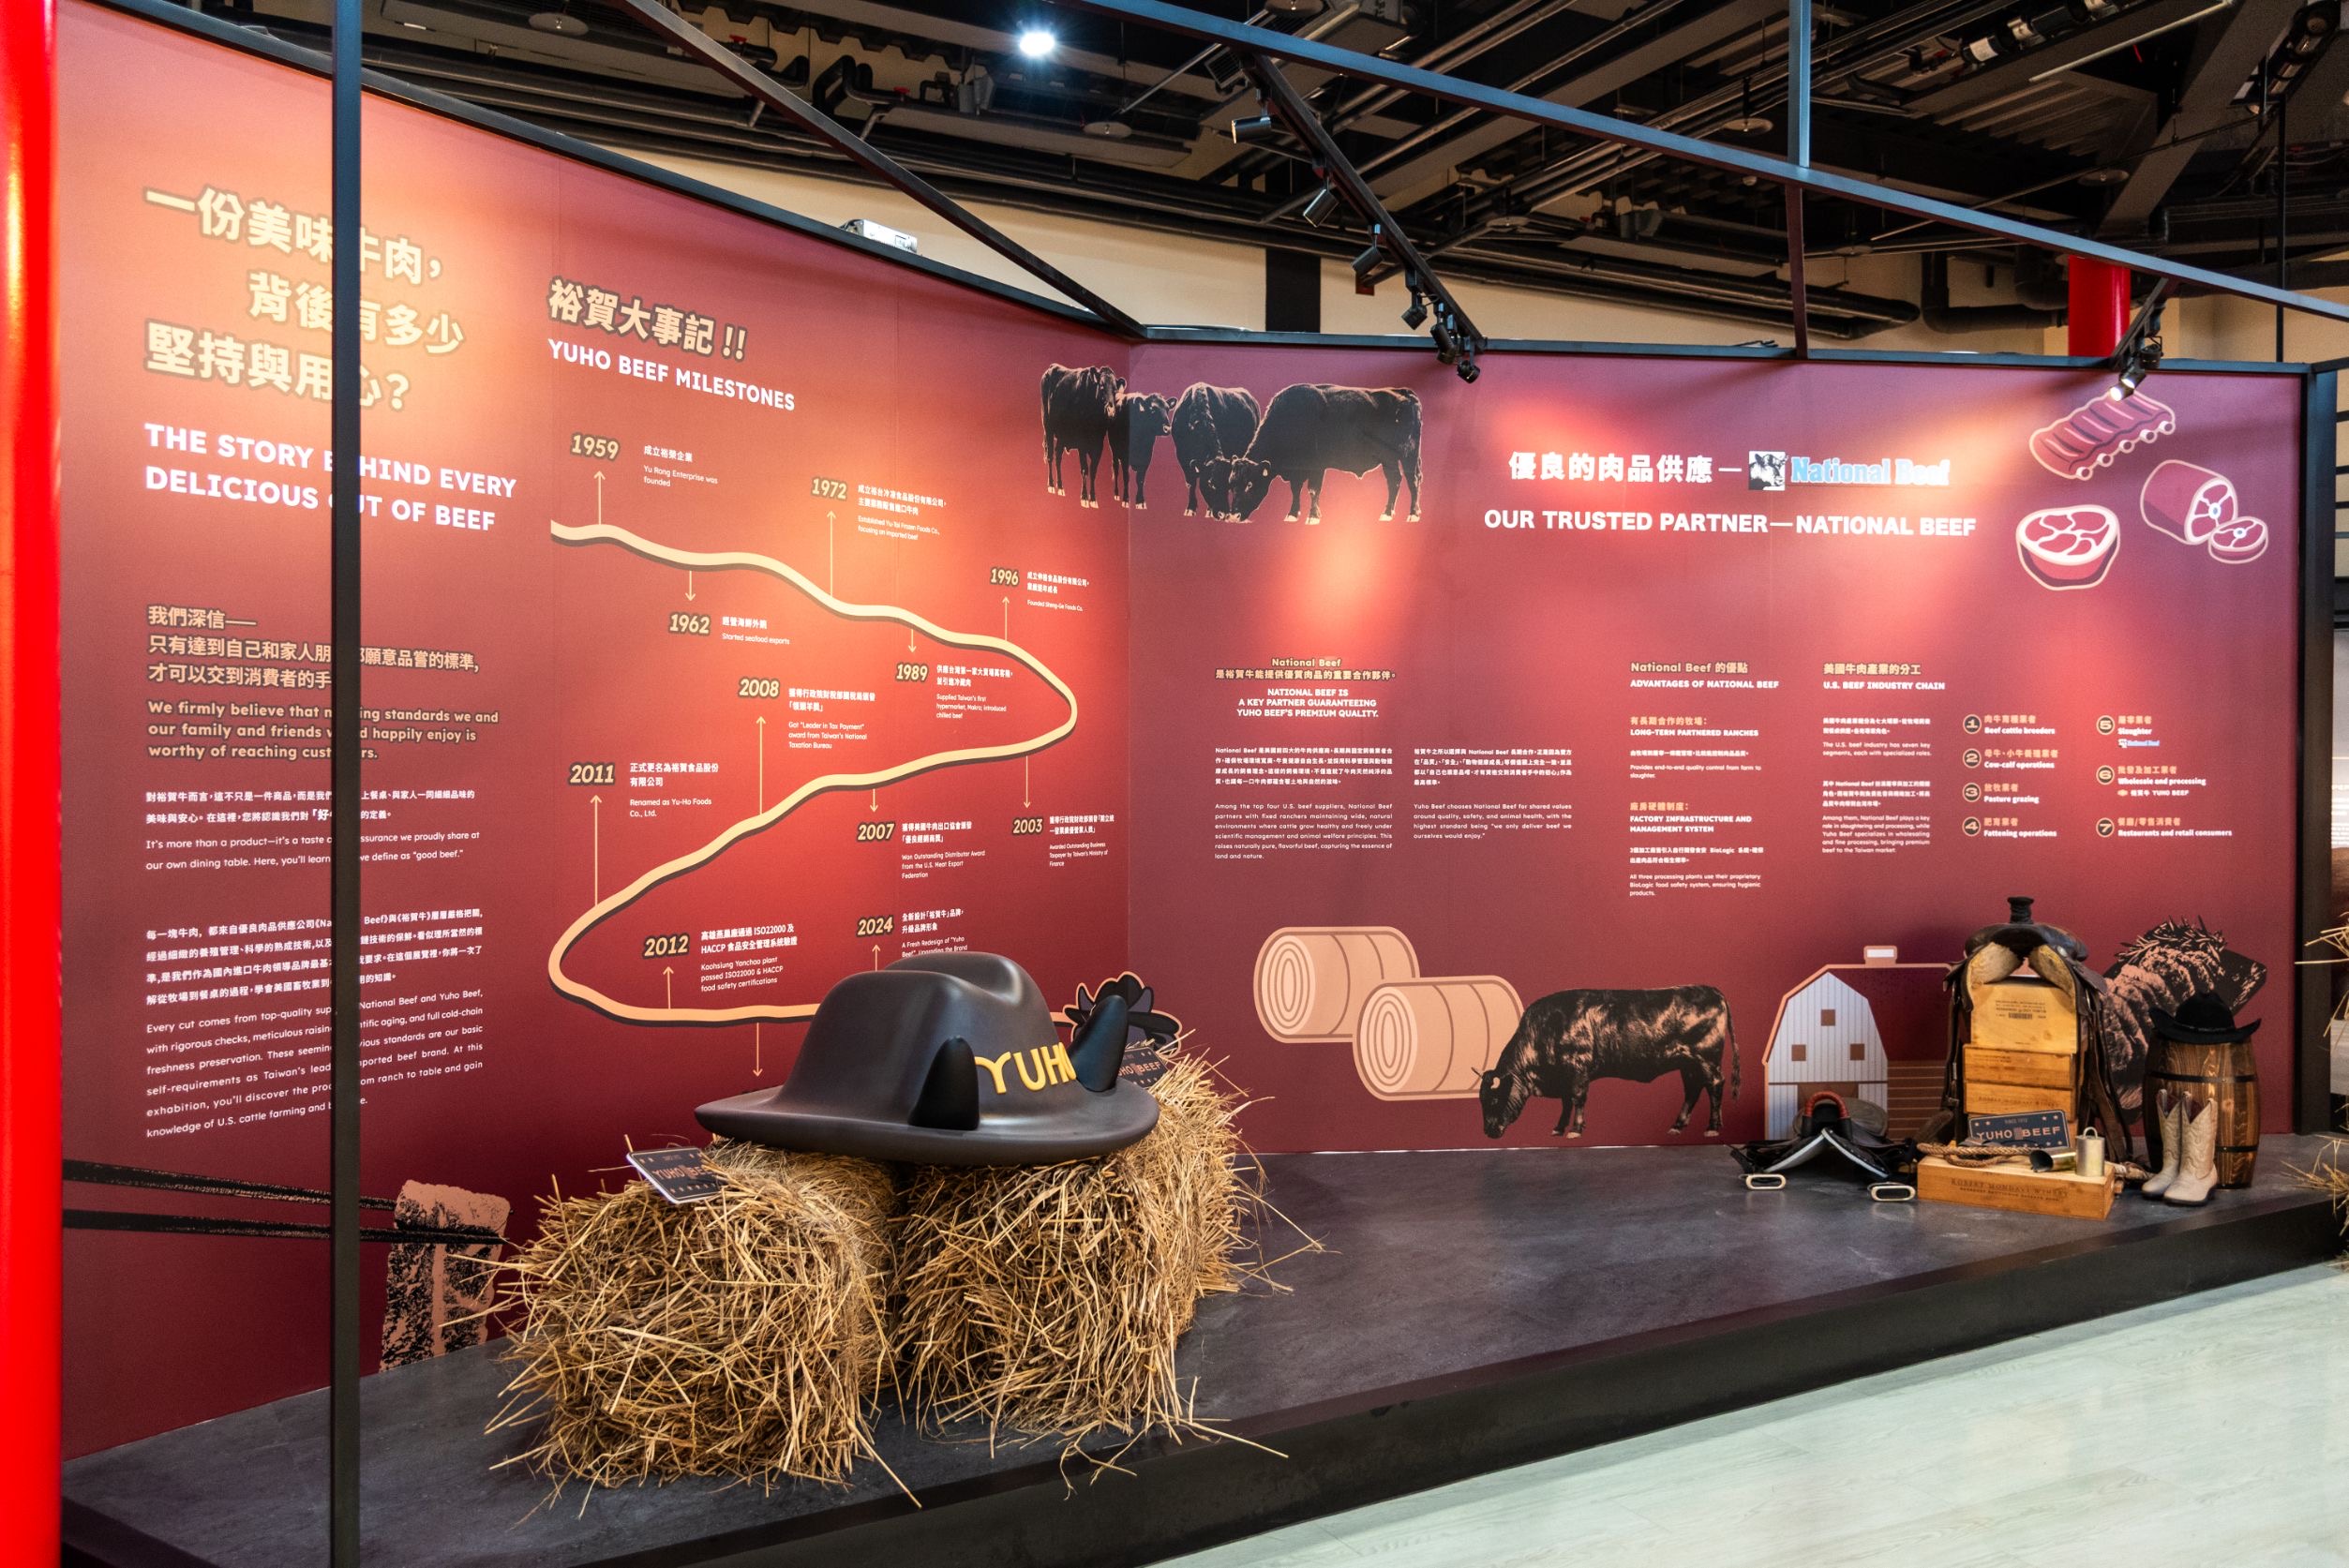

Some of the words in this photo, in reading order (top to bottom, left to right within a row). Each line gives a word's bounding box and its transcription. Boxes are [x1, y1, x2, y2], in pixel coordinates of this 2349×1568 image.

[548, 278, 714, 355] 裕賀大事記
[548, 338, 610, 369] YUHO
[620, 355, 668, 381] BEEF
[677, 368, 794, 411] MILESTONES
[572, 435, 620, 459] 1959
[144, 423, 206, 454] THE
[217, 435, 314, 468] STORY
[324, 450, 430, 485] HIND
[441, 468, 516, 498] EVERY
[1791, 456, 1891, 484] National
[1894, 458, 1951, 485] Beef
[812, 478, 847, 500] 1972
[146, 466, 318, 509] DELICIOUS
[392, 500, 426, 521] OF
[436, 505, 495, 530] BEEF
[1485, 510, 1534, 529] OUR
[1542, 511, 1653, 530] TRUSTED
[1920, 517, 1977, 536] BEEF
[990, 568, 1019, 586] 1996
[669, 613, 711, 635] 1962
[1271, 657, 1315, 667] National
[1318, 657, 1341, 667] Beef
[1630, 661, 1682, 673] National
[1685, 663, 1712, 673] Beef
[1715, 663, 1747, 673] 的優點
[895, 664, 928, 682] 1989
[740, 679, 780, 697] 2008
[1629, 679, 1690, 688] ADVANTAGES
[1691, 679, 1705, 688] OF
[1706, 679, 1755, 689] NATIONAL
[1756, 680, 1779, 689] BEEF
[1822, 680, 1841, 690] U.S.
[1842, 680, 1865, 690] BEEF
[1866, 680, 1914, 690] INDUSTRY
[1914, 681, 1946, 691] CHAIN
[1267, 688, 1313, 696] NATIONAL
[1314, 688, 1337, 697] BEEF
[1338, 688, 1349, 697] IS
[1238, 698, 1246, 707] A
[1247, 698, 1264, 707] KEY
[1265, 698, 1306, 707] PARTNER
[1307, 698, 1377, 708] GUARANTEEING
[147, 700, 173, 714] We
[177, 700, 226, 719] firmly
[231, 703, 285, 717] believe
[289, 705, 320, 718] that
[384, 709, 450, 722] standards
[454, 712, 471, 723] we
[474, 711, 499, 724] and
[1236, 709, 1263, 717] YUHO
[1294, 709, 1337, 718] PREMIUM
[1338, 709, 1379, 718] QUALITY.
[148, 724, 176, 735] our
[181, 723, 232, 739] family
[236, 724, 265, 737] and
[270, 724, 322, 739] friends
[372, 726, 423, 743] happily
[426, 728, 462, 743] enjoy
[466, 728, 476, 741] is
[1629, 728, 1676, 737] LONG-TERM
[1676, 728, 1722, 737] PARTNERED
[2099, 720, 2112, 730] 5
[2117, 726, 2153, 737] Slaughter
[148, 744, 205, 760] worthy
[210, 744, 227, 757] of
[232, 744, 297, 761] reaching
[302, 747, 379, 758] custrs.
[1966, 753, 1979, 763] 2
[570, 764, 615, 784] 2011
[630, 776, 664, 787] 有限公司
[1965, 788, 1979, 797] 3
[629, 798, 661, 807] Renamed
[671, 798, 692, 806] Yu-Ho
[692, 798, 712, 806] Foods
[858, 823, 895, 841] 2007
[1012, 819, 1043, 834] 2003
[1629, 825, 1683, 833] MANAGEMENT
[1684, 825, 1714, 833] SYSTEM
[1965, 822, 1979, 830] 4
[166, 840, 193, 848] more
[195, 839, 218, 848] than
[219, 839, 228, 847] a
[292, 837, 299, 845] a
[300, 836, 325, 844] taste
[360, 834, 398, 843] ssurance
[413, 831, 445, 843] proudly
[446, 831, 470, 841] share
[471, 831, 481, 840] at
[858, 917, 893, 935] 2024
[644, 936, 690, 957] 2012
[700, 962, 734, 971] Kaohsiung
[735, 958, 761, 967] Yanchao
[761, 956, 778, 965] plant
[700, 974, 725, 983] passed
[725, 968, 756, 979] ISO22000
[762, 964, 784, 975] HACCP
[700, 983, 716, 993] food
[717, 981, 738, 991] safety
[738, 977, 778, 988] certifications
[146, 1023, 175, 1034] Every
[178, 1020, 196, 1030] cut
[198, 1017, 232, 1028] comes
[233, 1014, 258, 1023] from
[261, 1008, 313, 1022] top-quality
[359, 997, 396, 1009] National
[398, 995, 418, 1006] Beef
[420, 993, 437, 1003] and
[439, 992, 460, 1001] Yuho
[462, 988, 484, 999] Beef,
[1135, 1060, 1162, 1074] BEEF
[1976, 1127, 2013, 1142] YUHO
[2021, 1126, 2061, 1139] BEEF
[651, 1167, 686, 1181] YUHO
